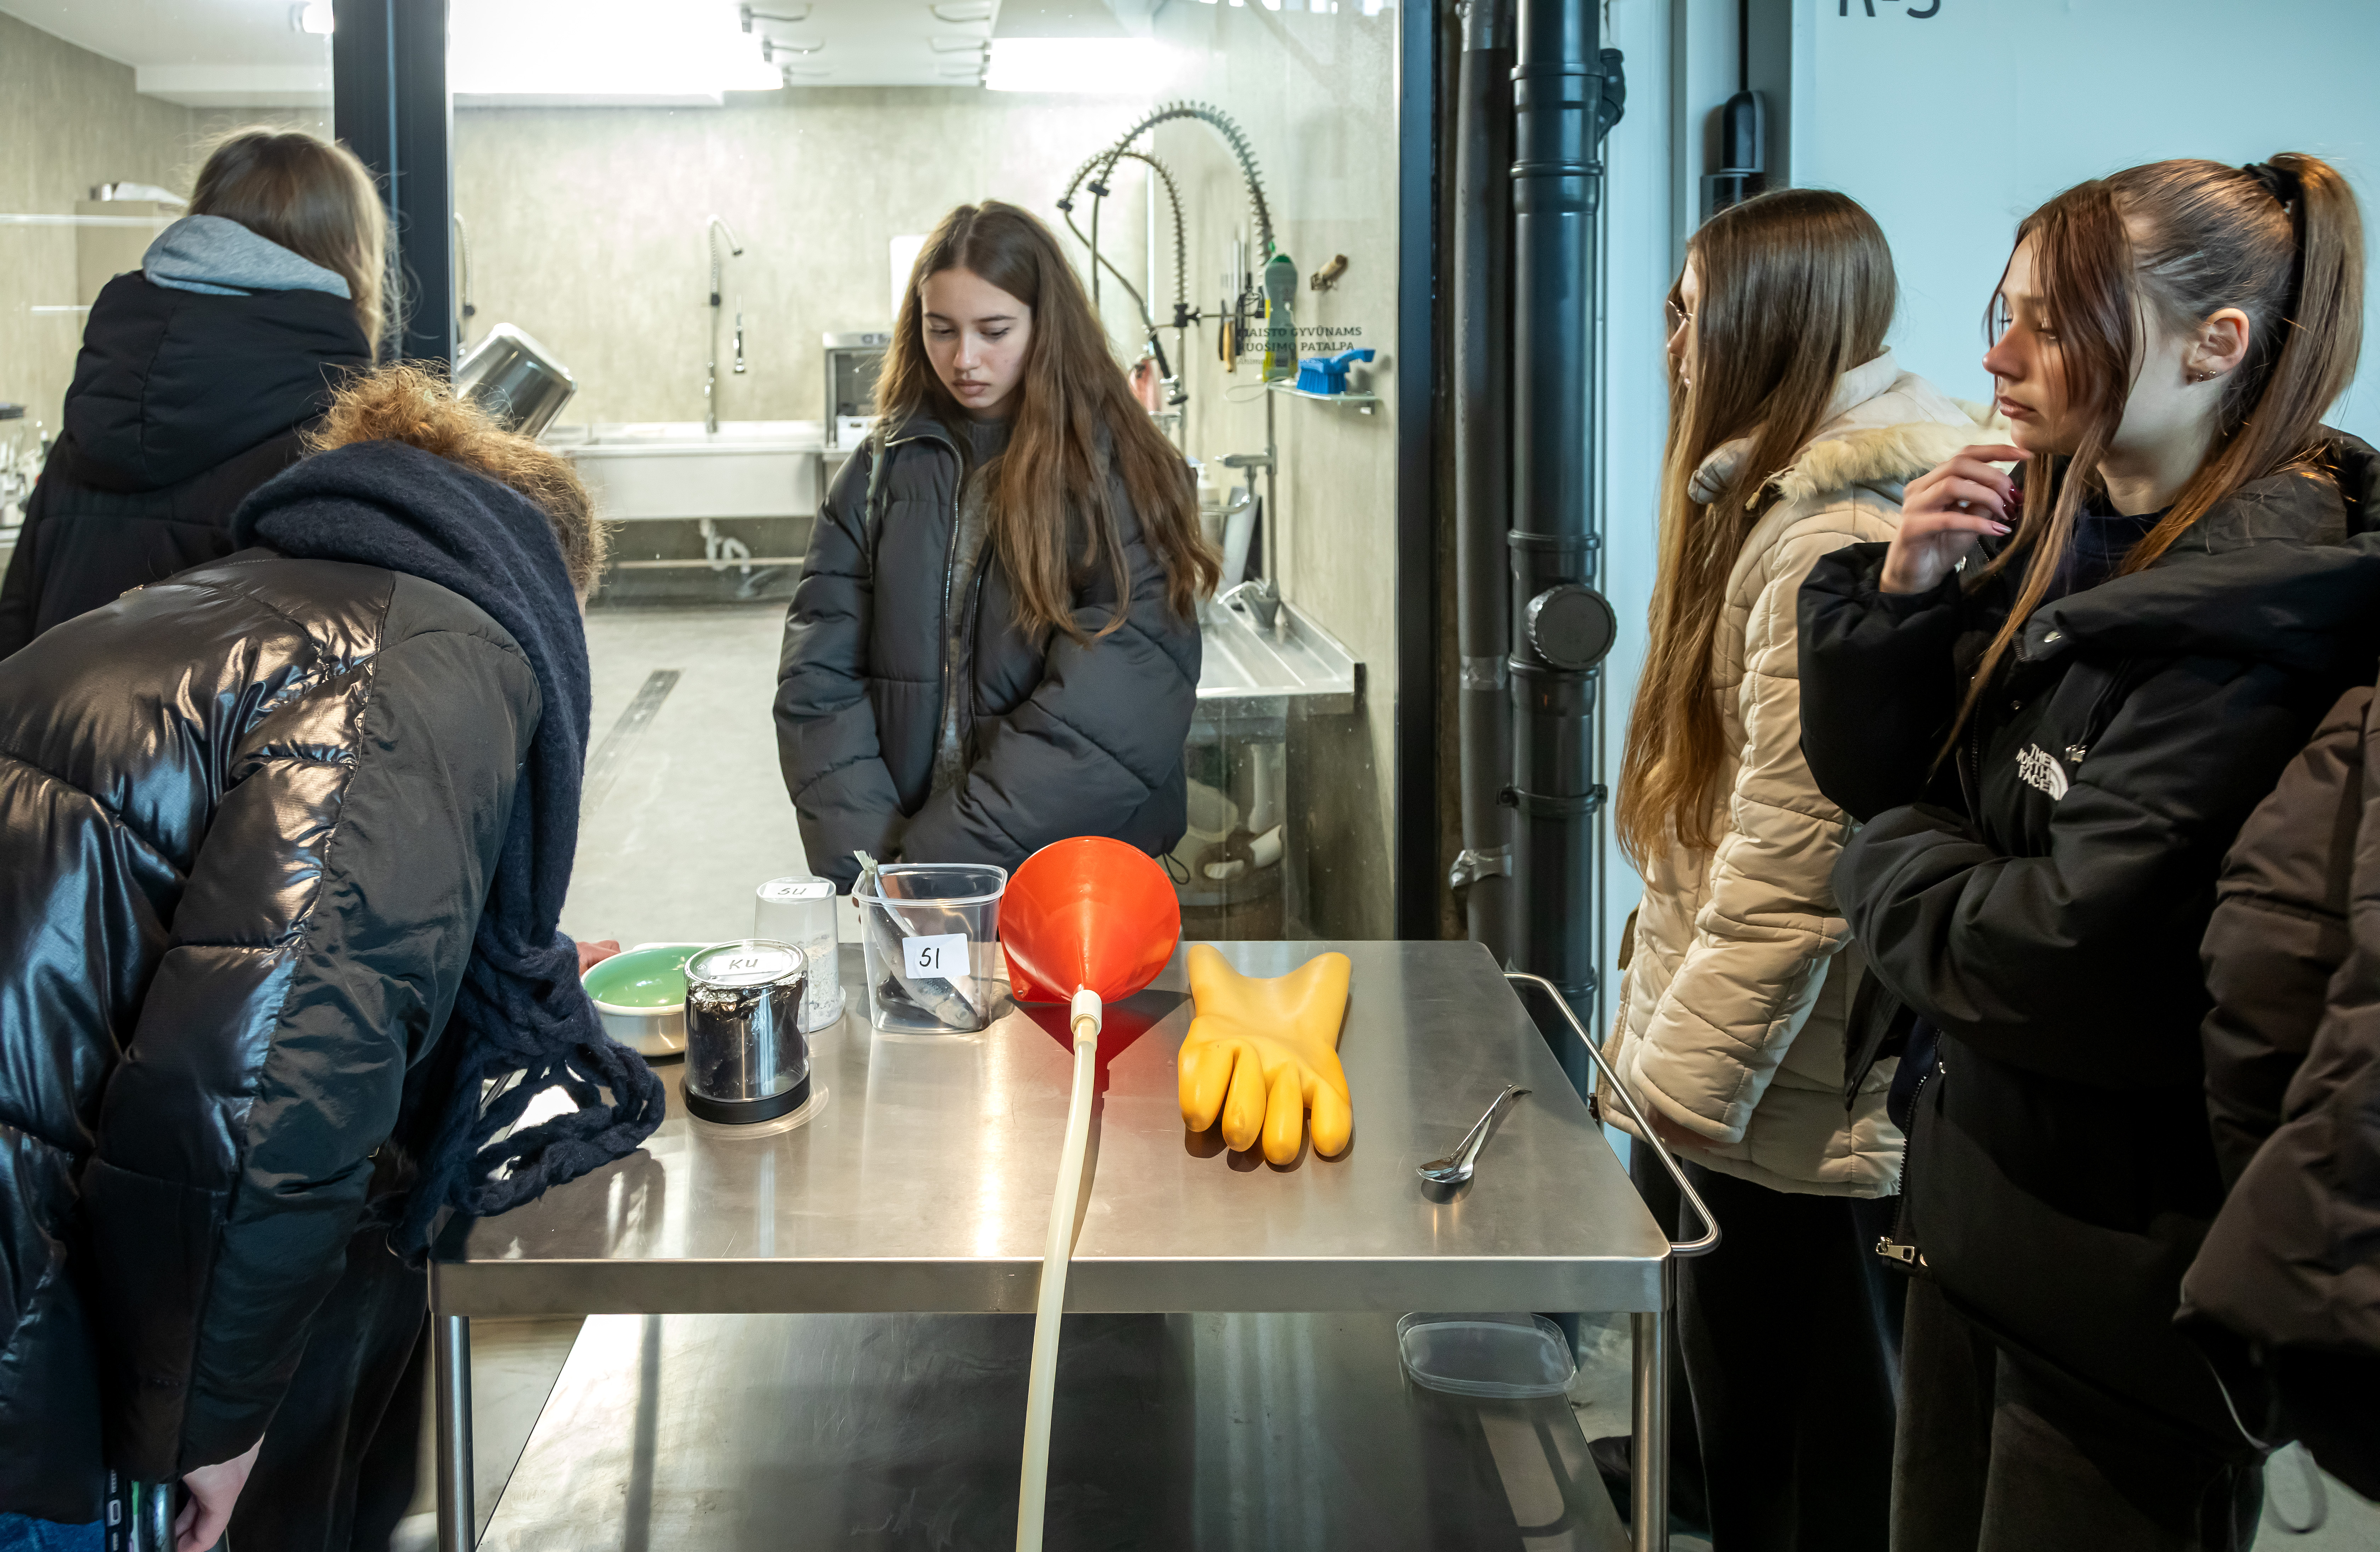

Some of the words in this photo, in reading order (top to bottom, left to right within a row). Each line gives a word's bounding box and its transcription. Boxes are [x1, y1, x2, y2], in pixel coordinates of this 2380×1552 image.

[1291, 325, 1362, 337] GYVŪNAMS
[1301, 341, 1355, 351] PATALPA
[2031, 743, 2050, 766] THE
[2018, 764, 2049, 793] FACE
[729, 959, 758, 969] KU
